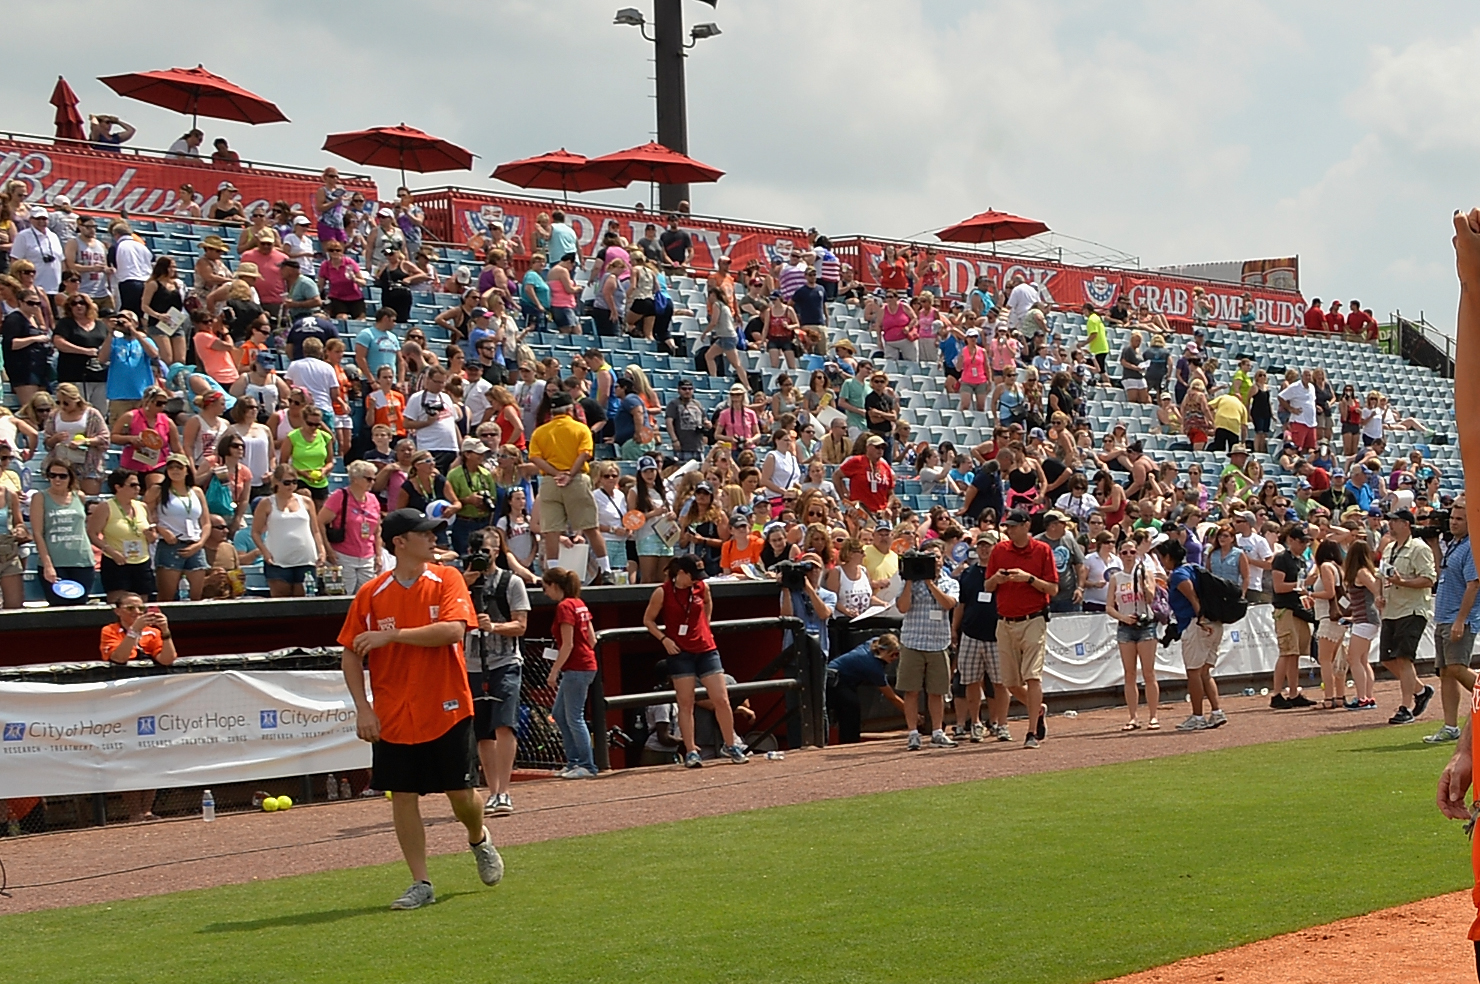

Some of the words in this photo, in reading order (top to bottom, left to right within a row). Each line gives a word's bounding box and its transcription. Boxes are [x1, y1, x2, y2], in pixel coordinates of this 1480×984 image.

[1129, 284, 1188, 316] GRAB
[1254, 298, 1306, 328] BUDS
[866, 470, 890, 486] USA
[158, 714, 191, 733] City
[205, 712, 245, 730] Hope
[279, 709, 310, 727] City
[325, 707, 357, 723] Hop
[29, 722, 65, 740] City
[80, 720, 122, 738] Hope
